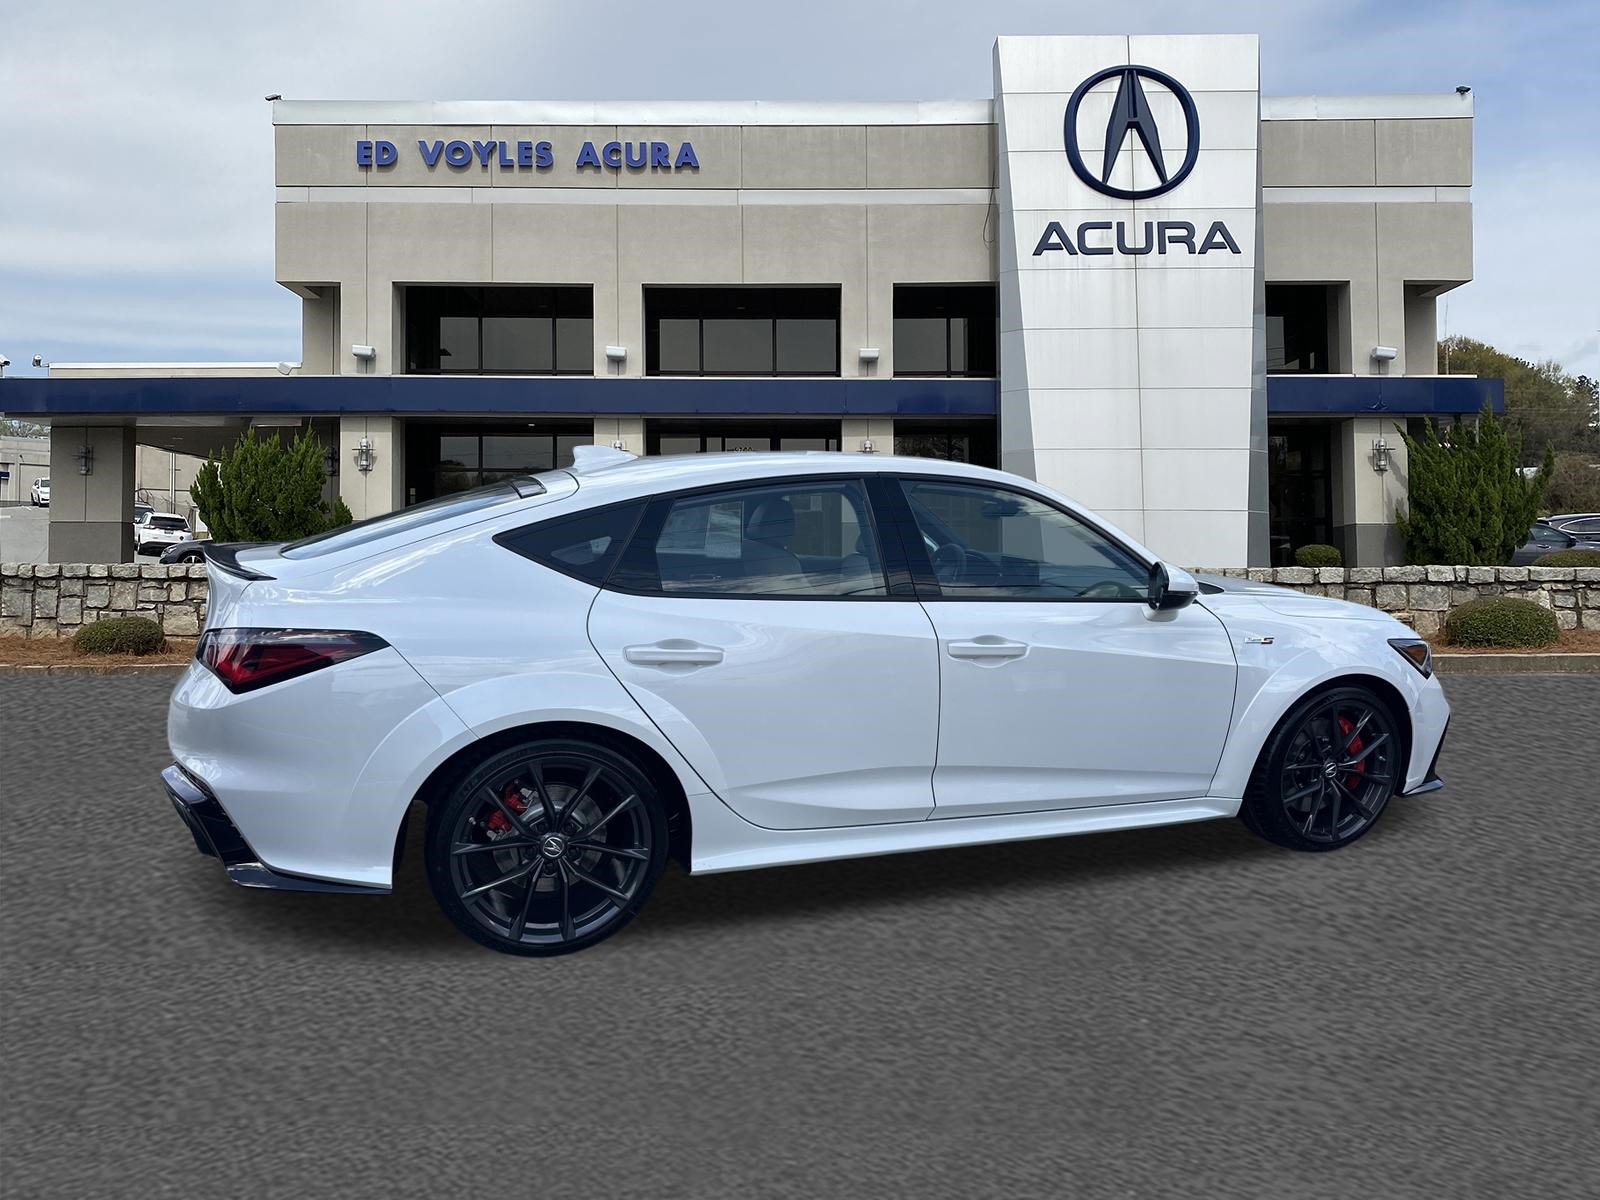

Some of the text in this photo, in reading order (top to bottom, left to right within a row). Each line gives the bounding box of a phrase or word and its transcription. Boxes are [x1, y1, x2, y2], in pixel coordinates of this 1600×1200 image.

[356, 140, 700, 168] ED VOYLES ACURA
[1032, 221, 1242, 256] ACURA
